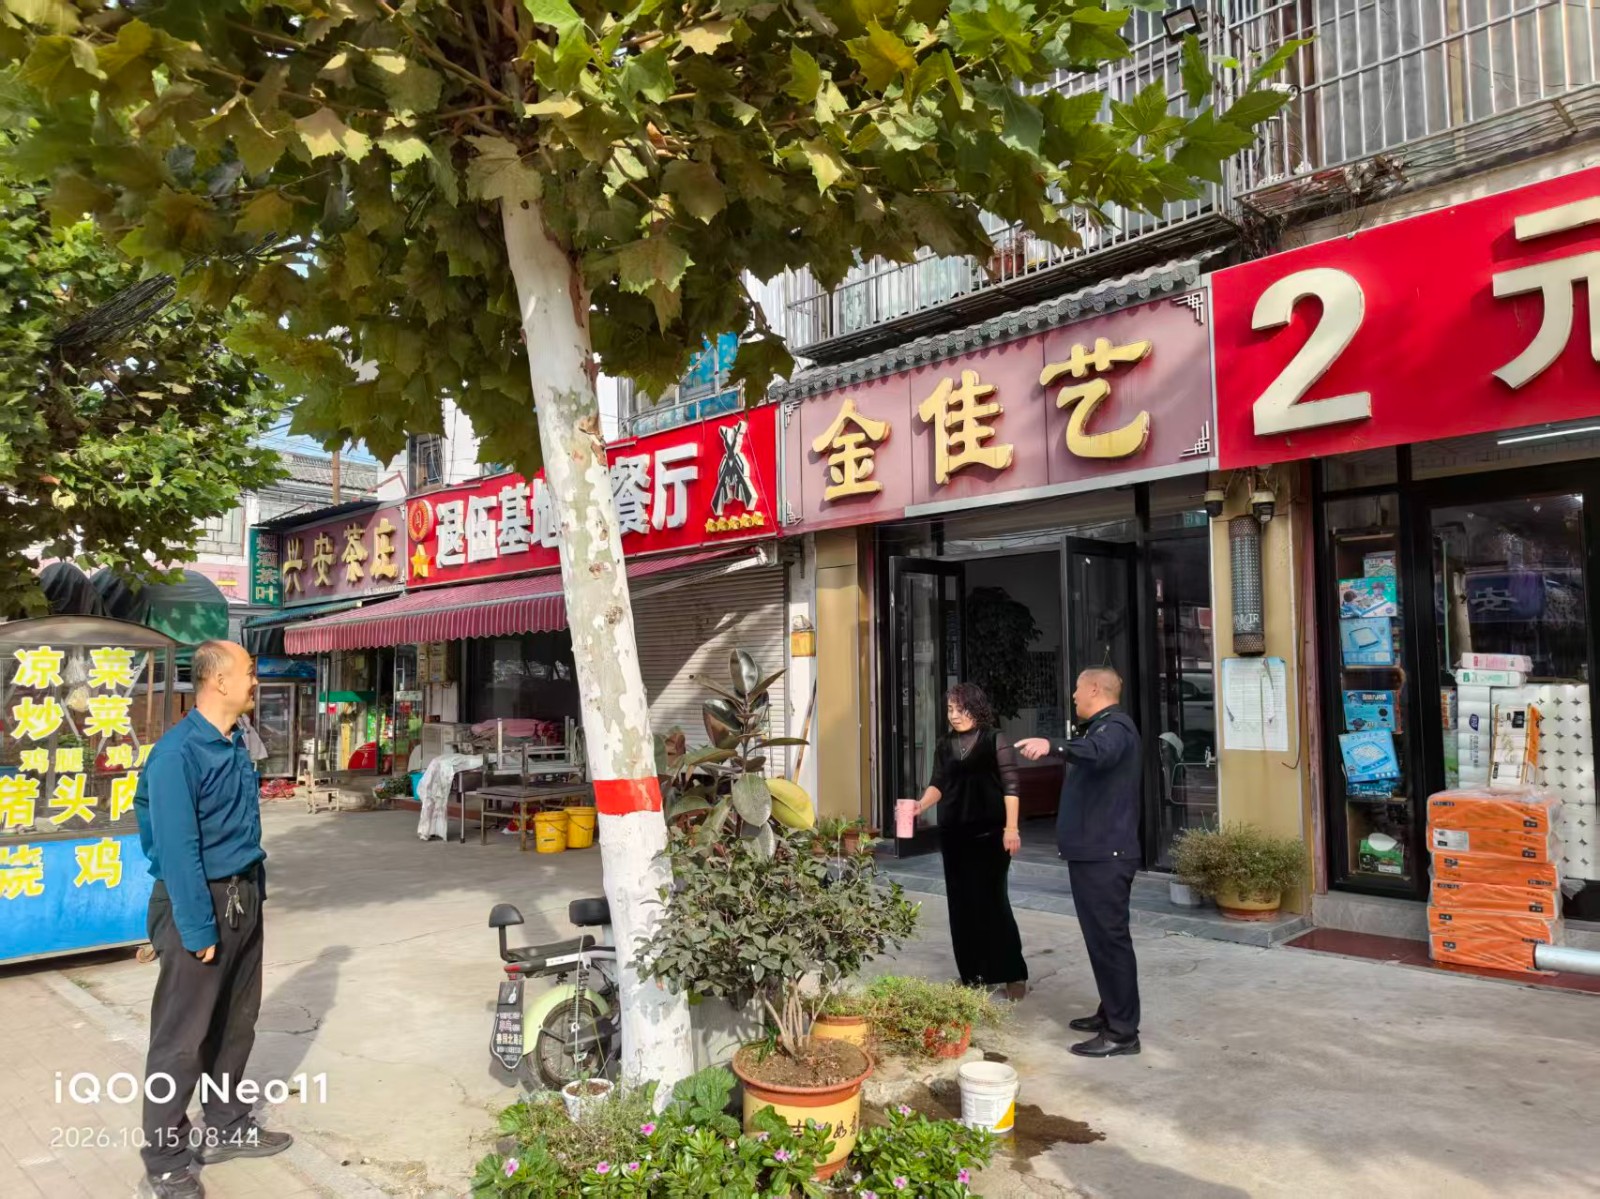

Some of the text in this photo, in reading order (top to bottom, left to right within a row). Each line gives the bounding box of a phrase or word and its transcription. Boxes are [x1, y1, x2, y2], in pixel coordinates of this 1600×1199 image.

[812, 337, 1152, 501] 金佳艺
[282, 517, 399, 594] 兴安茶庄
[12, 646, 136, 690] 凉菜
[10, 694, 133, 742] 炒菜
